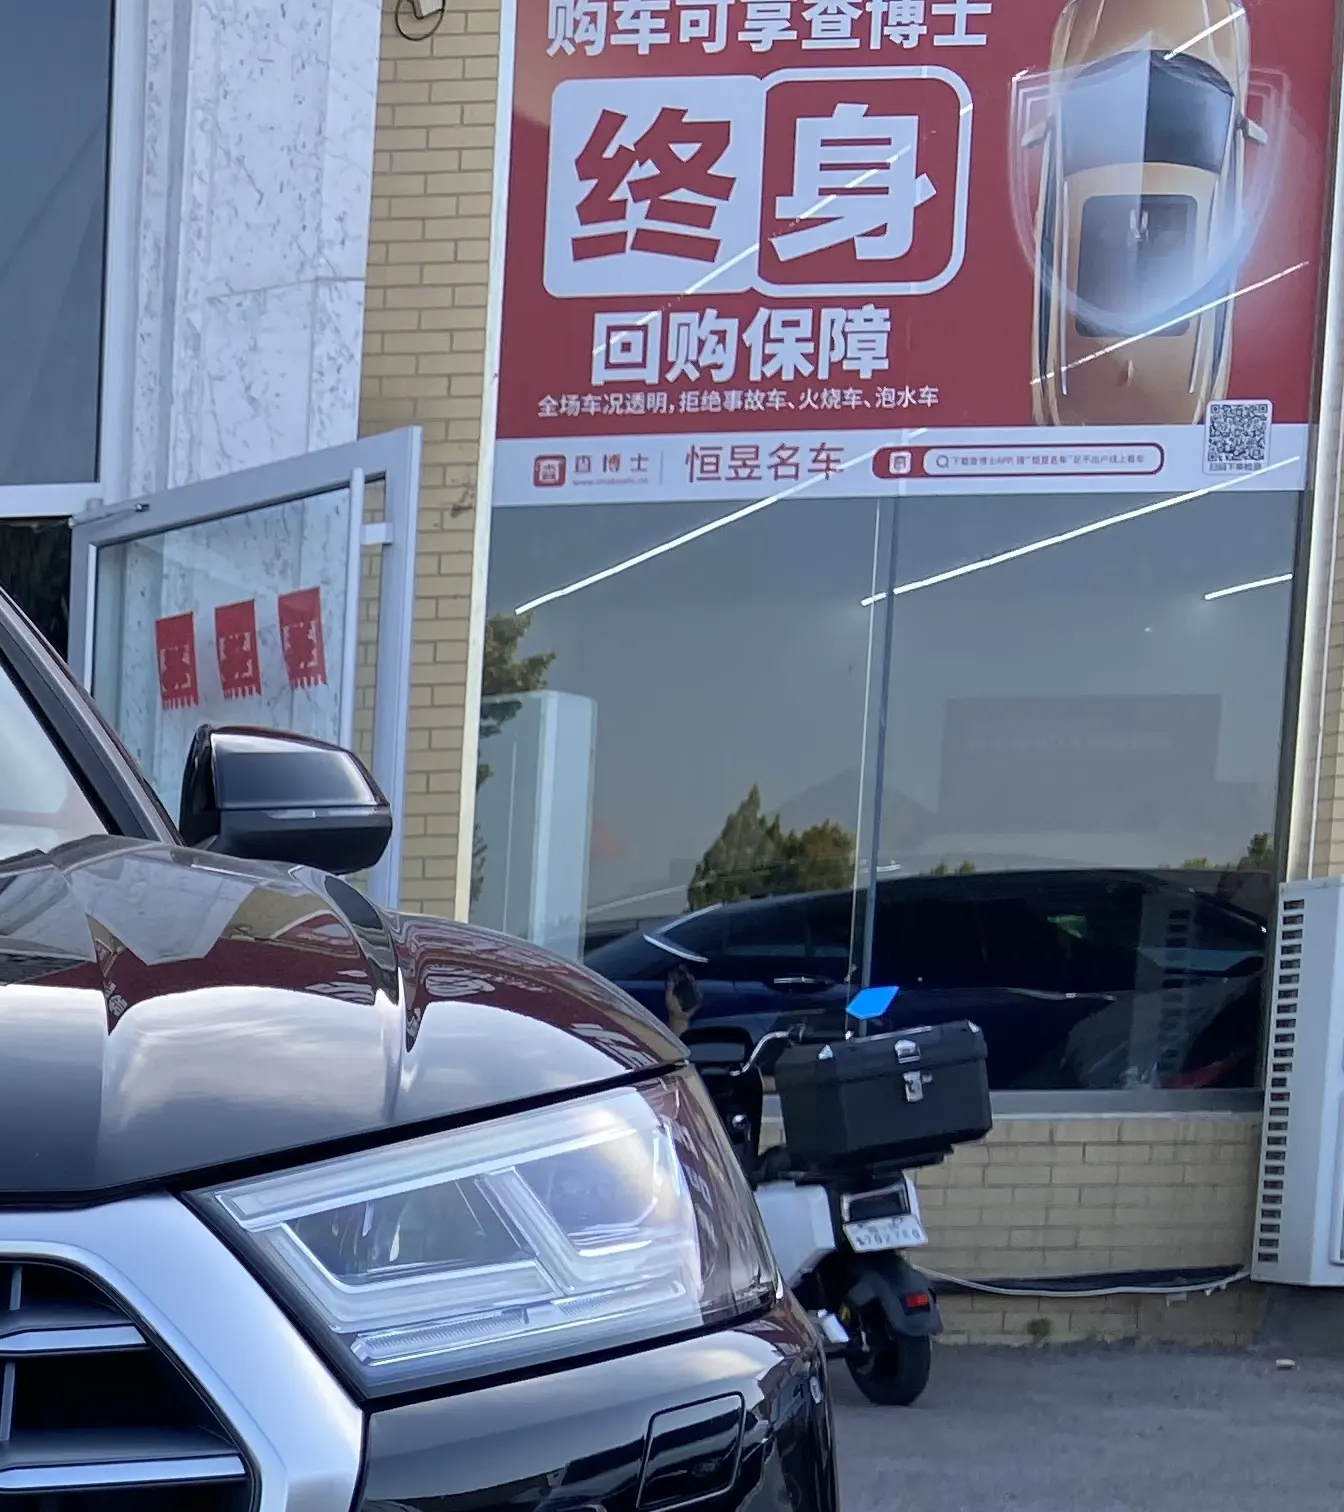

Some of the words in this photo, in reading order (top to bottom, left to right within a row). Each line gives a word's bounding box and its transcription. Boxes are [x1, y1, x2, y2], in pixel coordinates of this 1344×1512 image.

[546, 0, 993, 57] 购车可享查博士
[571, 102, 938, 262] 终身
[591, 304, 891, 385] 回购保障
[685, 442, 845, 483] 恒昱名车
